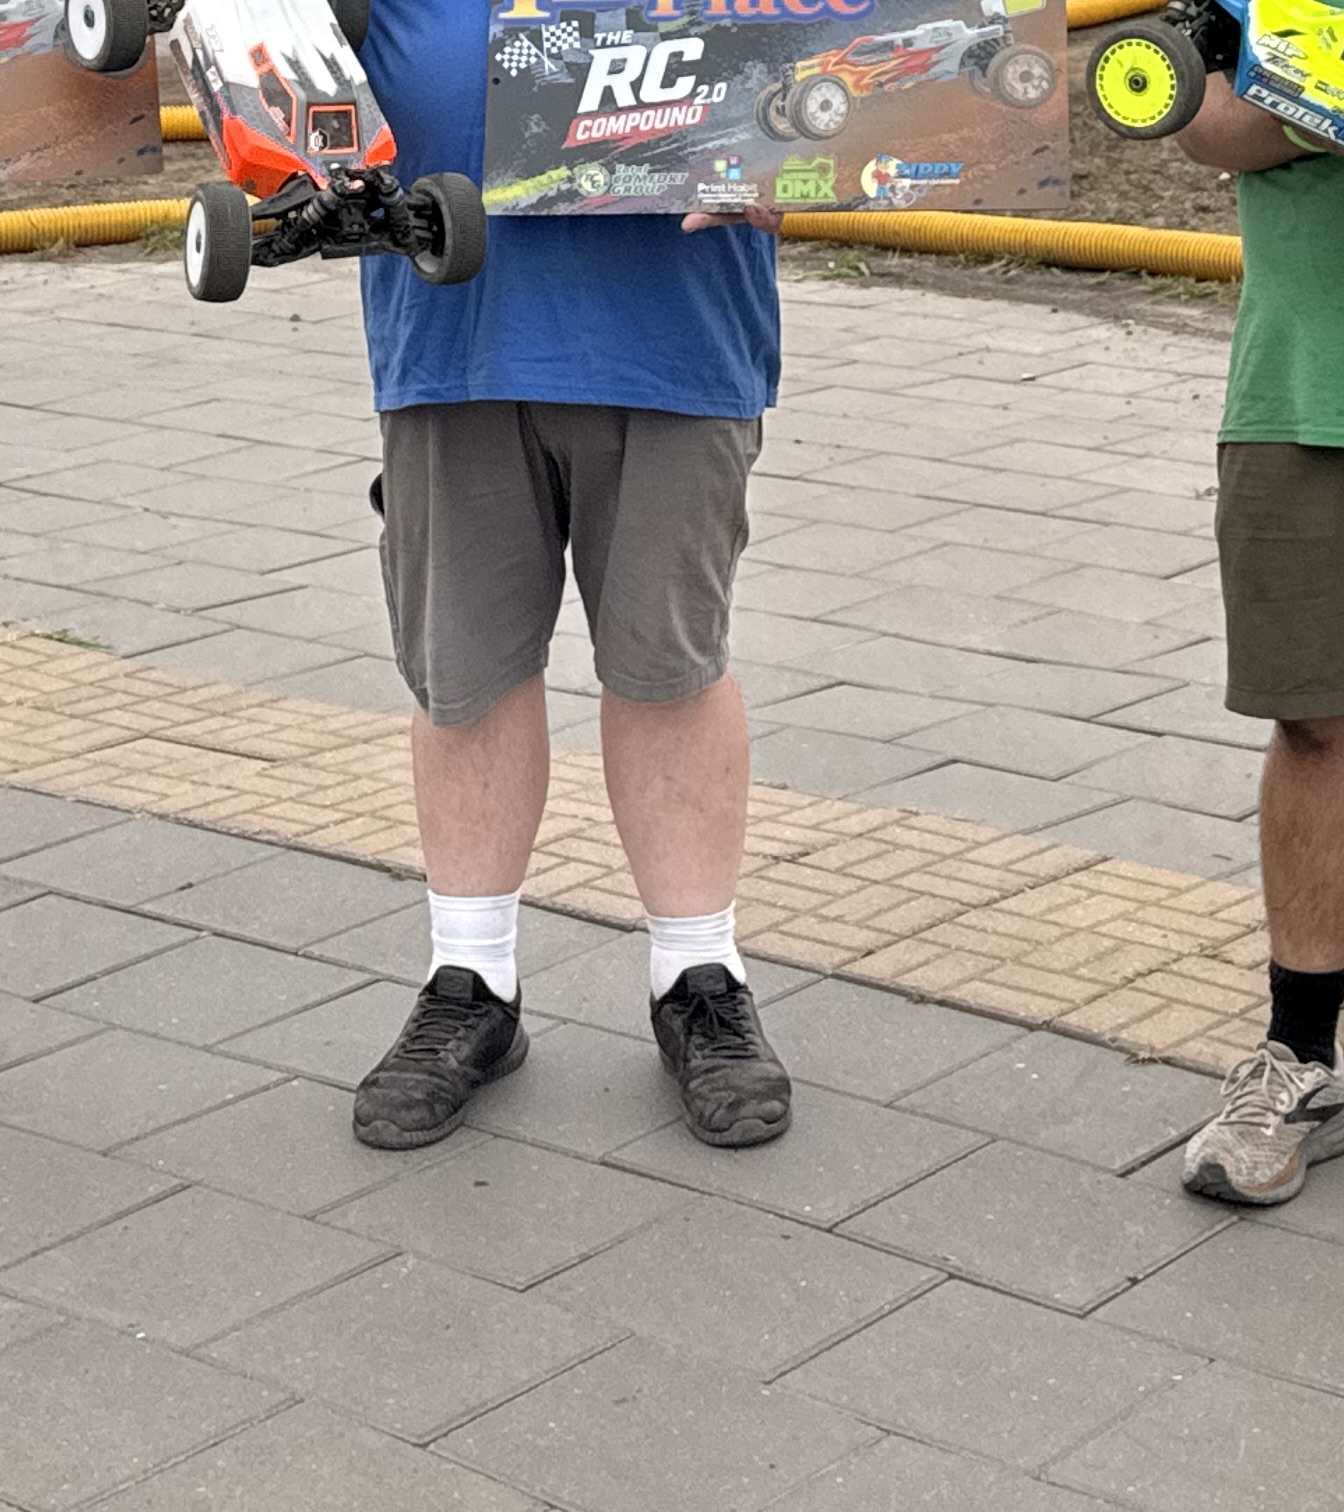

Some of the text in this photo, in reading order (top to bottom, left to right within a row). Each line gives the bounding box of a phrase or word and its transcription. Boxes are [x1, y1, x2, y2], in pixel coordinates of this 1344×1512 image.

[594, 29, 634, 47] THE
[577, 37, 704, 113] RC
[693, 82, 728, 105] 2.0
[576, 105, 704, 141] COMPOUND
[612, 173, 689, 185] COMFORT
[697, 183, 725, 193] Print
[775, 178, 837, 198] DMX
[611, 184, 668, 196] GROUP
